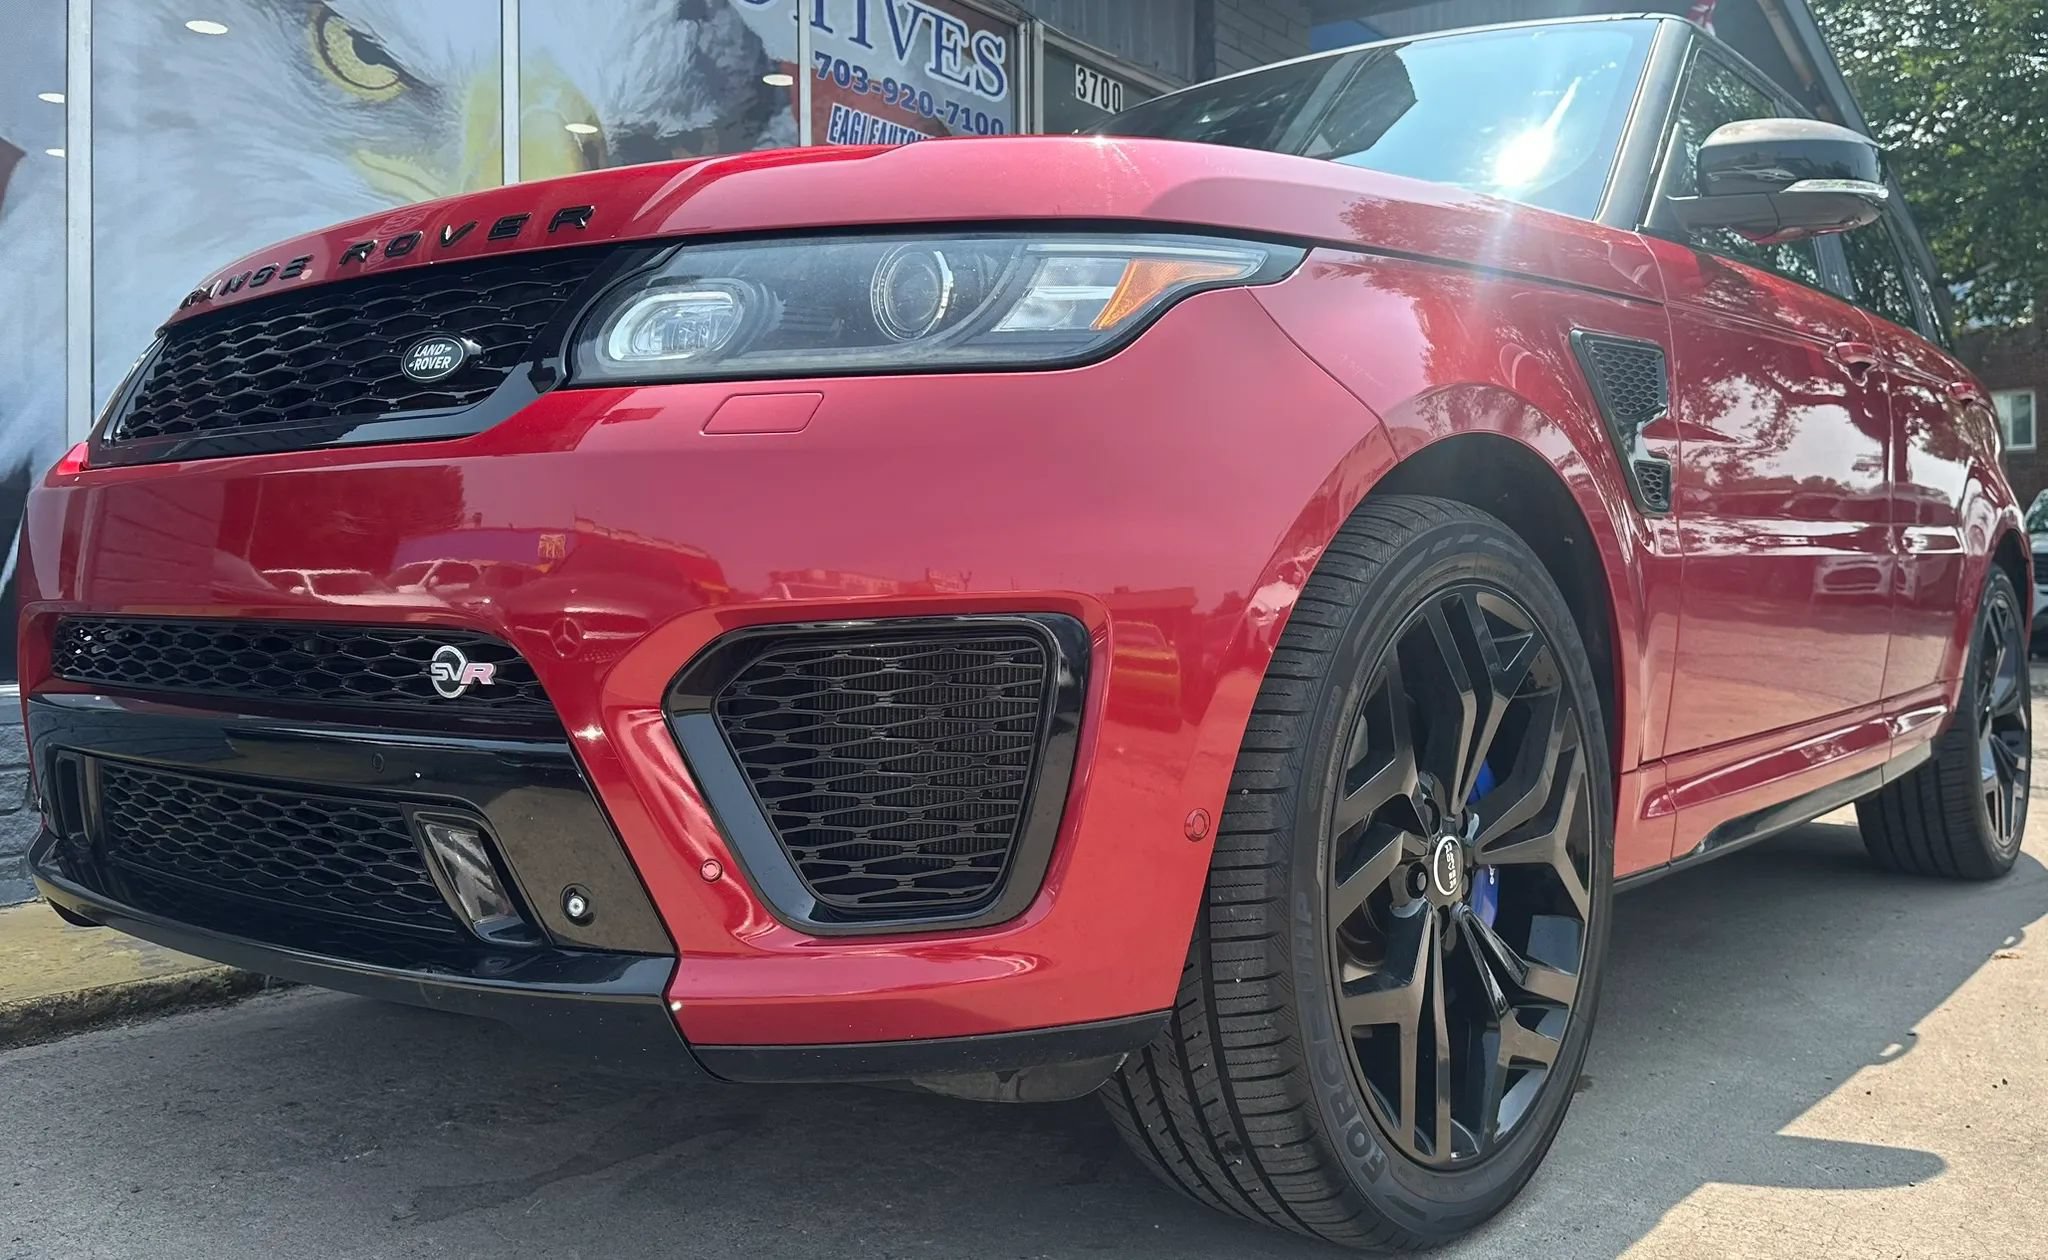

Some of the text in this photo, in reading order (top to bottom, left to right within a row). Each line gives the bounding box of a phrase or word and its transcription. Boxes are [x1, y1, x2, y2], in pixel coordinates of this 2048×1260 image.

[814, 50, 1005, 136] 703-920-7100
[1077, 67, 1121, 113] 3700
[179, 205, 596, 311] RANGE ROVER
[412, 356, 452, 371] ROVER
[413, 343, 447, 358] LAND
